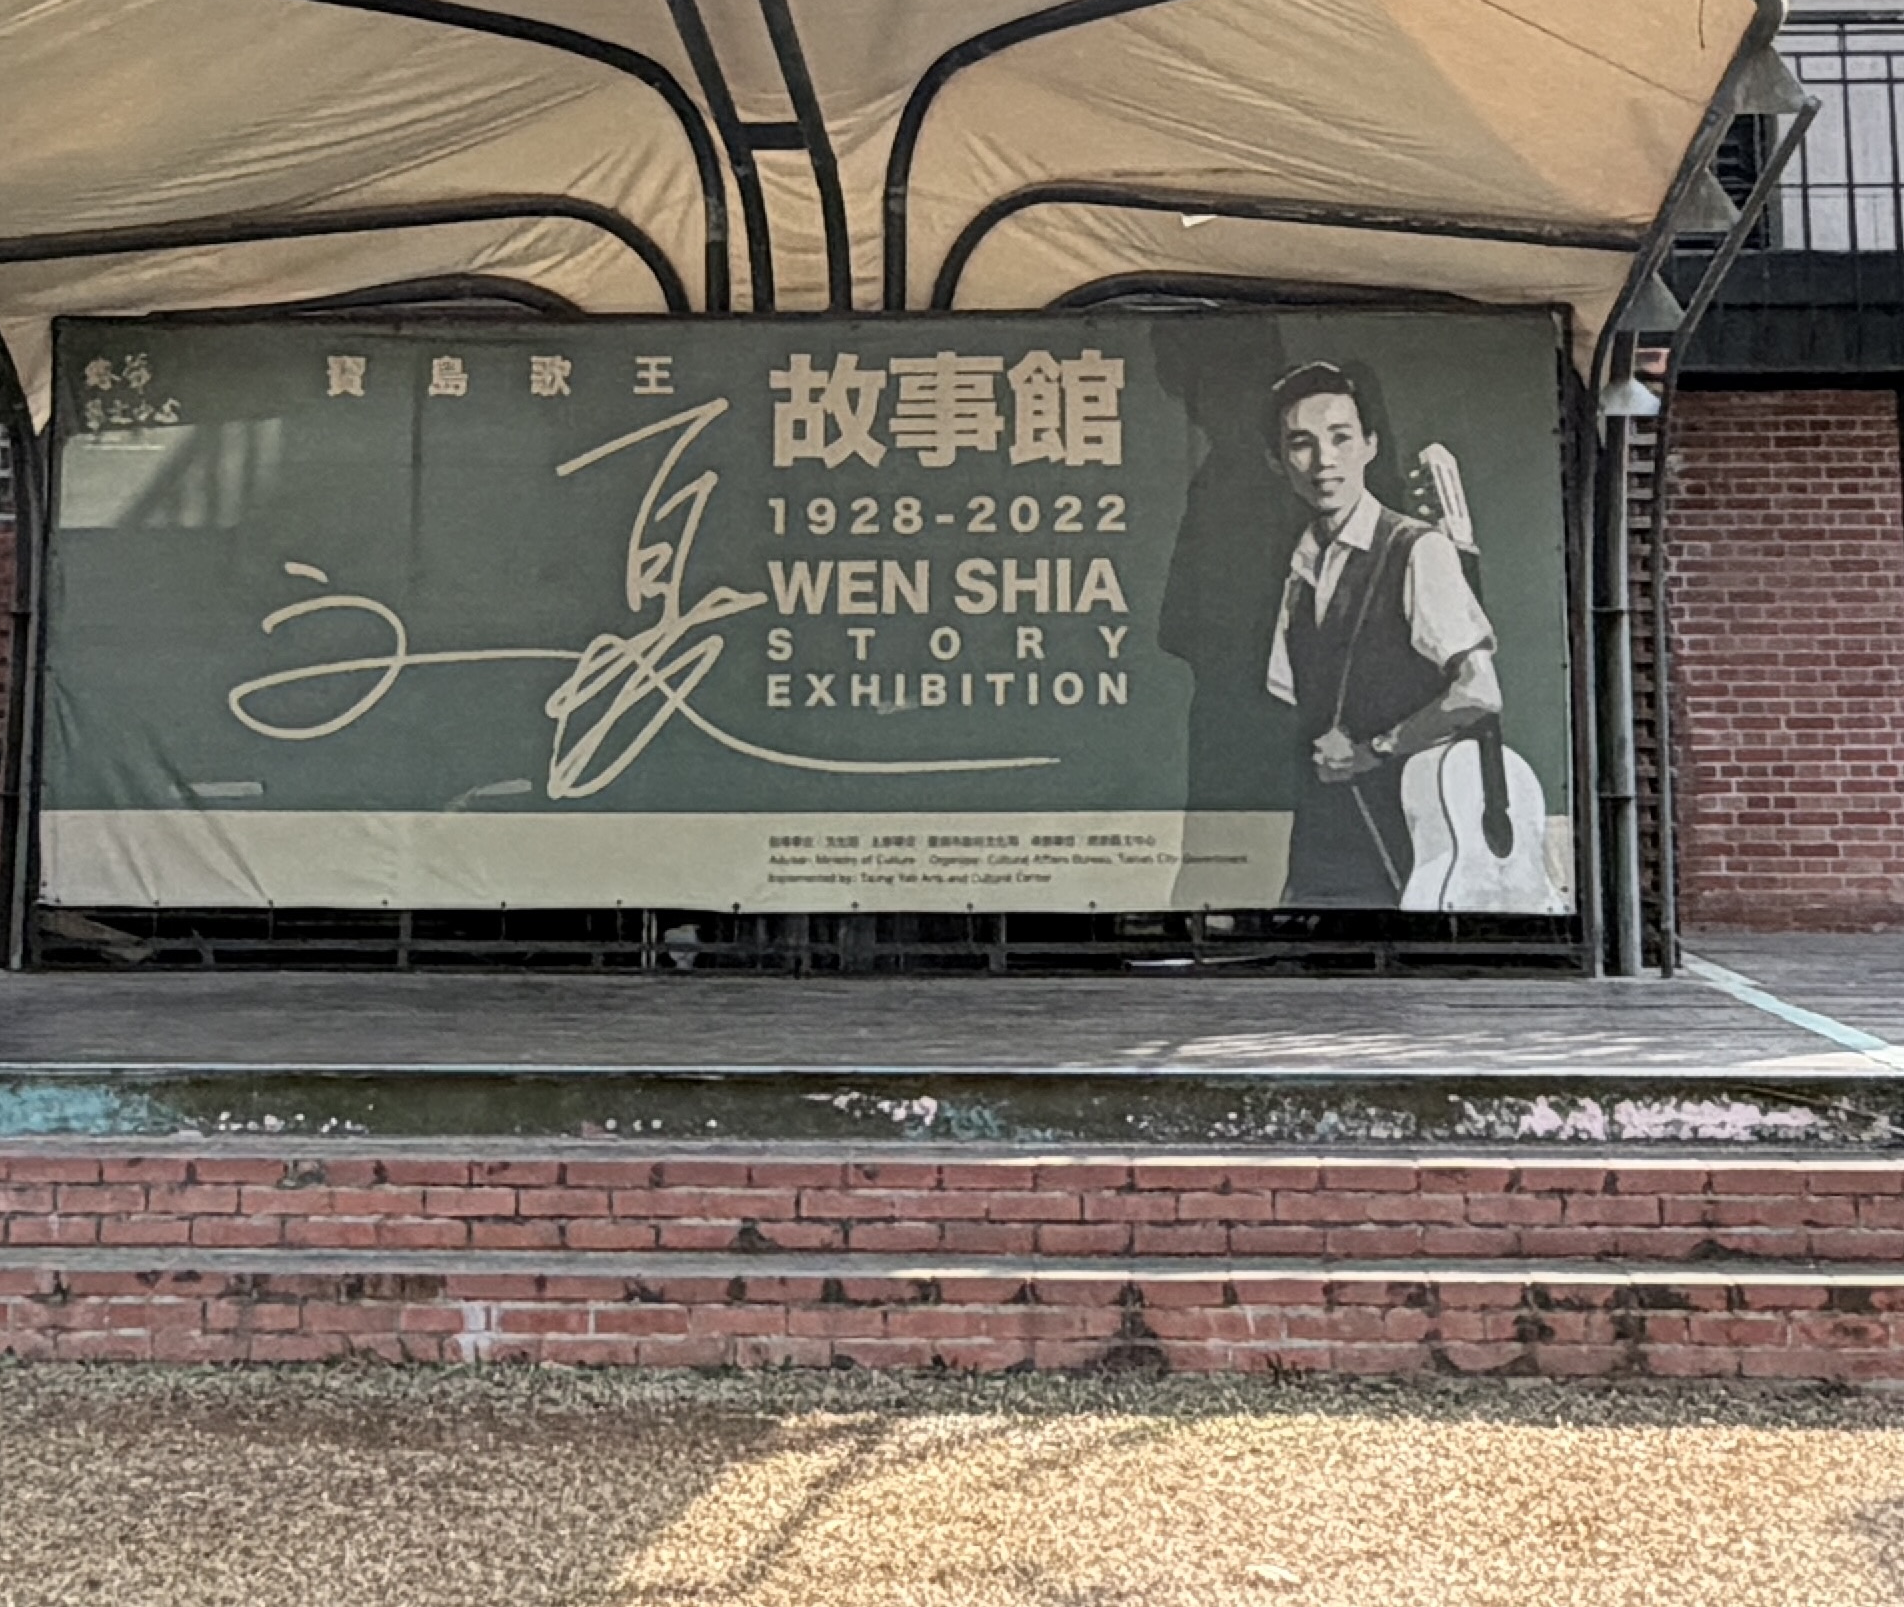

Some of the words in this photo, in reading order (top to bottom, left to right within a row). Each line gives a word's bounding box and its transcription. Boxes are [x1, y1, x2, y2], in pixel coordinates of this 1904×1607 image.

[326, 355, 675, 397] 寶島歌王
[769, 349, 1126, 469] 故事館
[767, 495, 1128, 535] 1928-2022
[767, 559, 930, 615] WEN
[953, 557, 1130, 615] SHIA
[766, 625, 1129, 661] STORY
[766, 671, 1129, 707] EXHIBITION
